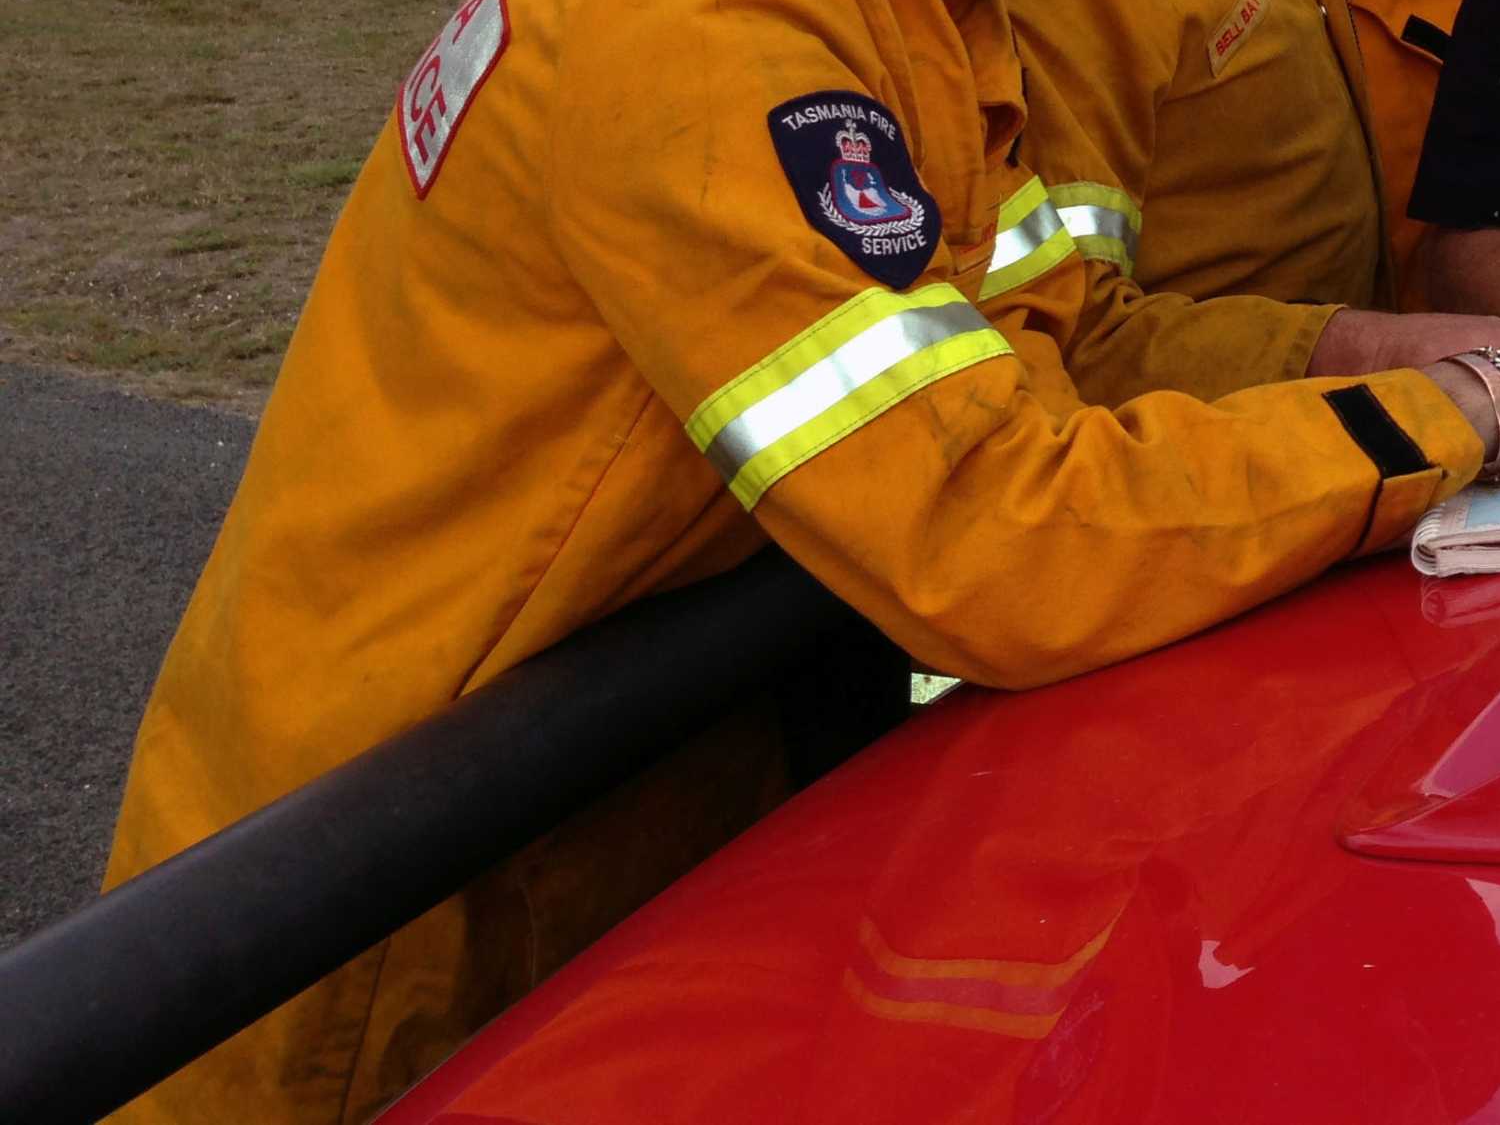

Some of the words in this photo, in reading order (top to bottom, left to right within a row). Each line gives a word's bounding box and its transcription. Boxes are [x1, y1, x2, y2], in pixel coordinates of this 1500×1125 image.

[782, 103, 867, 131] TASMANIA
[869, 110, 897, 142] FIRE
[861, 228, 928, 256] SERVICE
